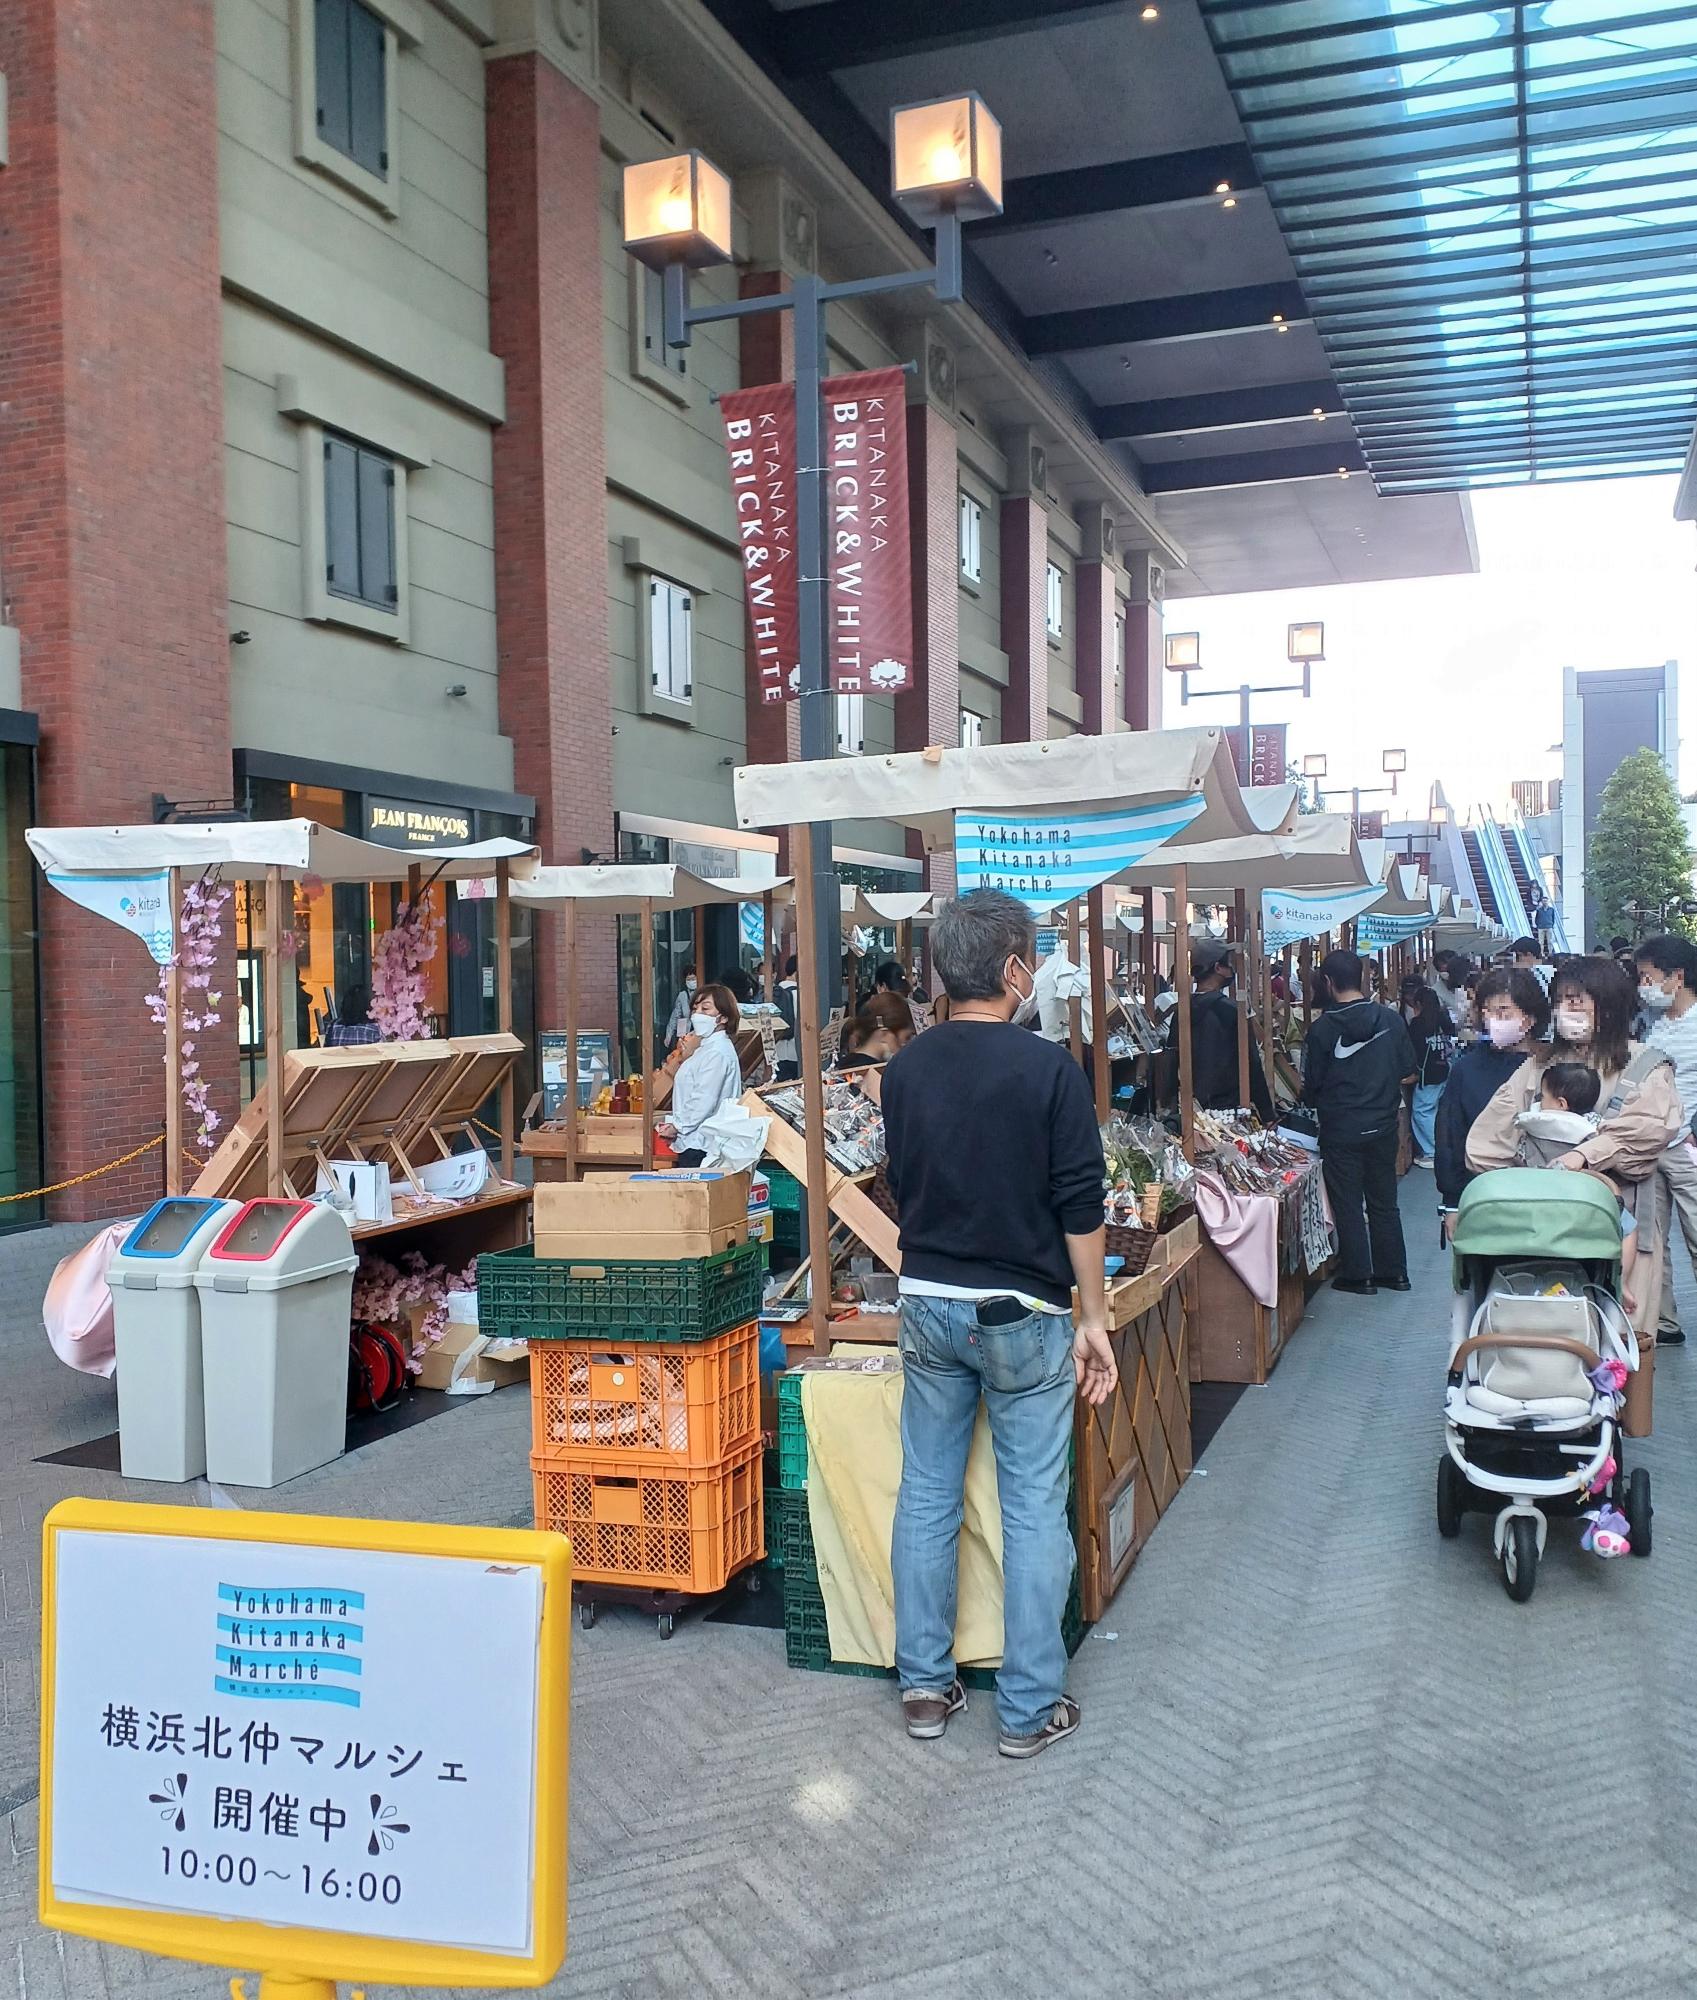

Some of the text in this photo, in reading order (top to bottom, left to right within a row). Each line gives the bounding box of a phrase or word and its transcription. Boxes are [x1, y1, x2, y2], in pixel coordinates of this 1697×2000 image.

[758, 412, 791, 564] KITANAKA
[866, 398, 888, 552] KITANAKA
[726, 418, 783, 702] BRICK&WHITE
[833, 402, 863, 691] BRICK&WHITE
[371, 807, 469, 839] JEAN FRANÇOIS
[408, 832, 436, 842] FRANCE
[978, 825, 1071, 845] Yokohama
[979, 849, 1072, 869] Kitanaka
[979, 873, 1052, 893] Marché
[1286, 907, 1333, 922] kitanaka
[233, 1590, 348, 1617] Yokohama
[231, 1622, 346, 1651] Kitanaka
[229, 1655, 320, 1681] Marché
[100, 1702, 470, 1784] 横浜北仲マルシェ
[213, 1785, 348, 1844] 開催中
